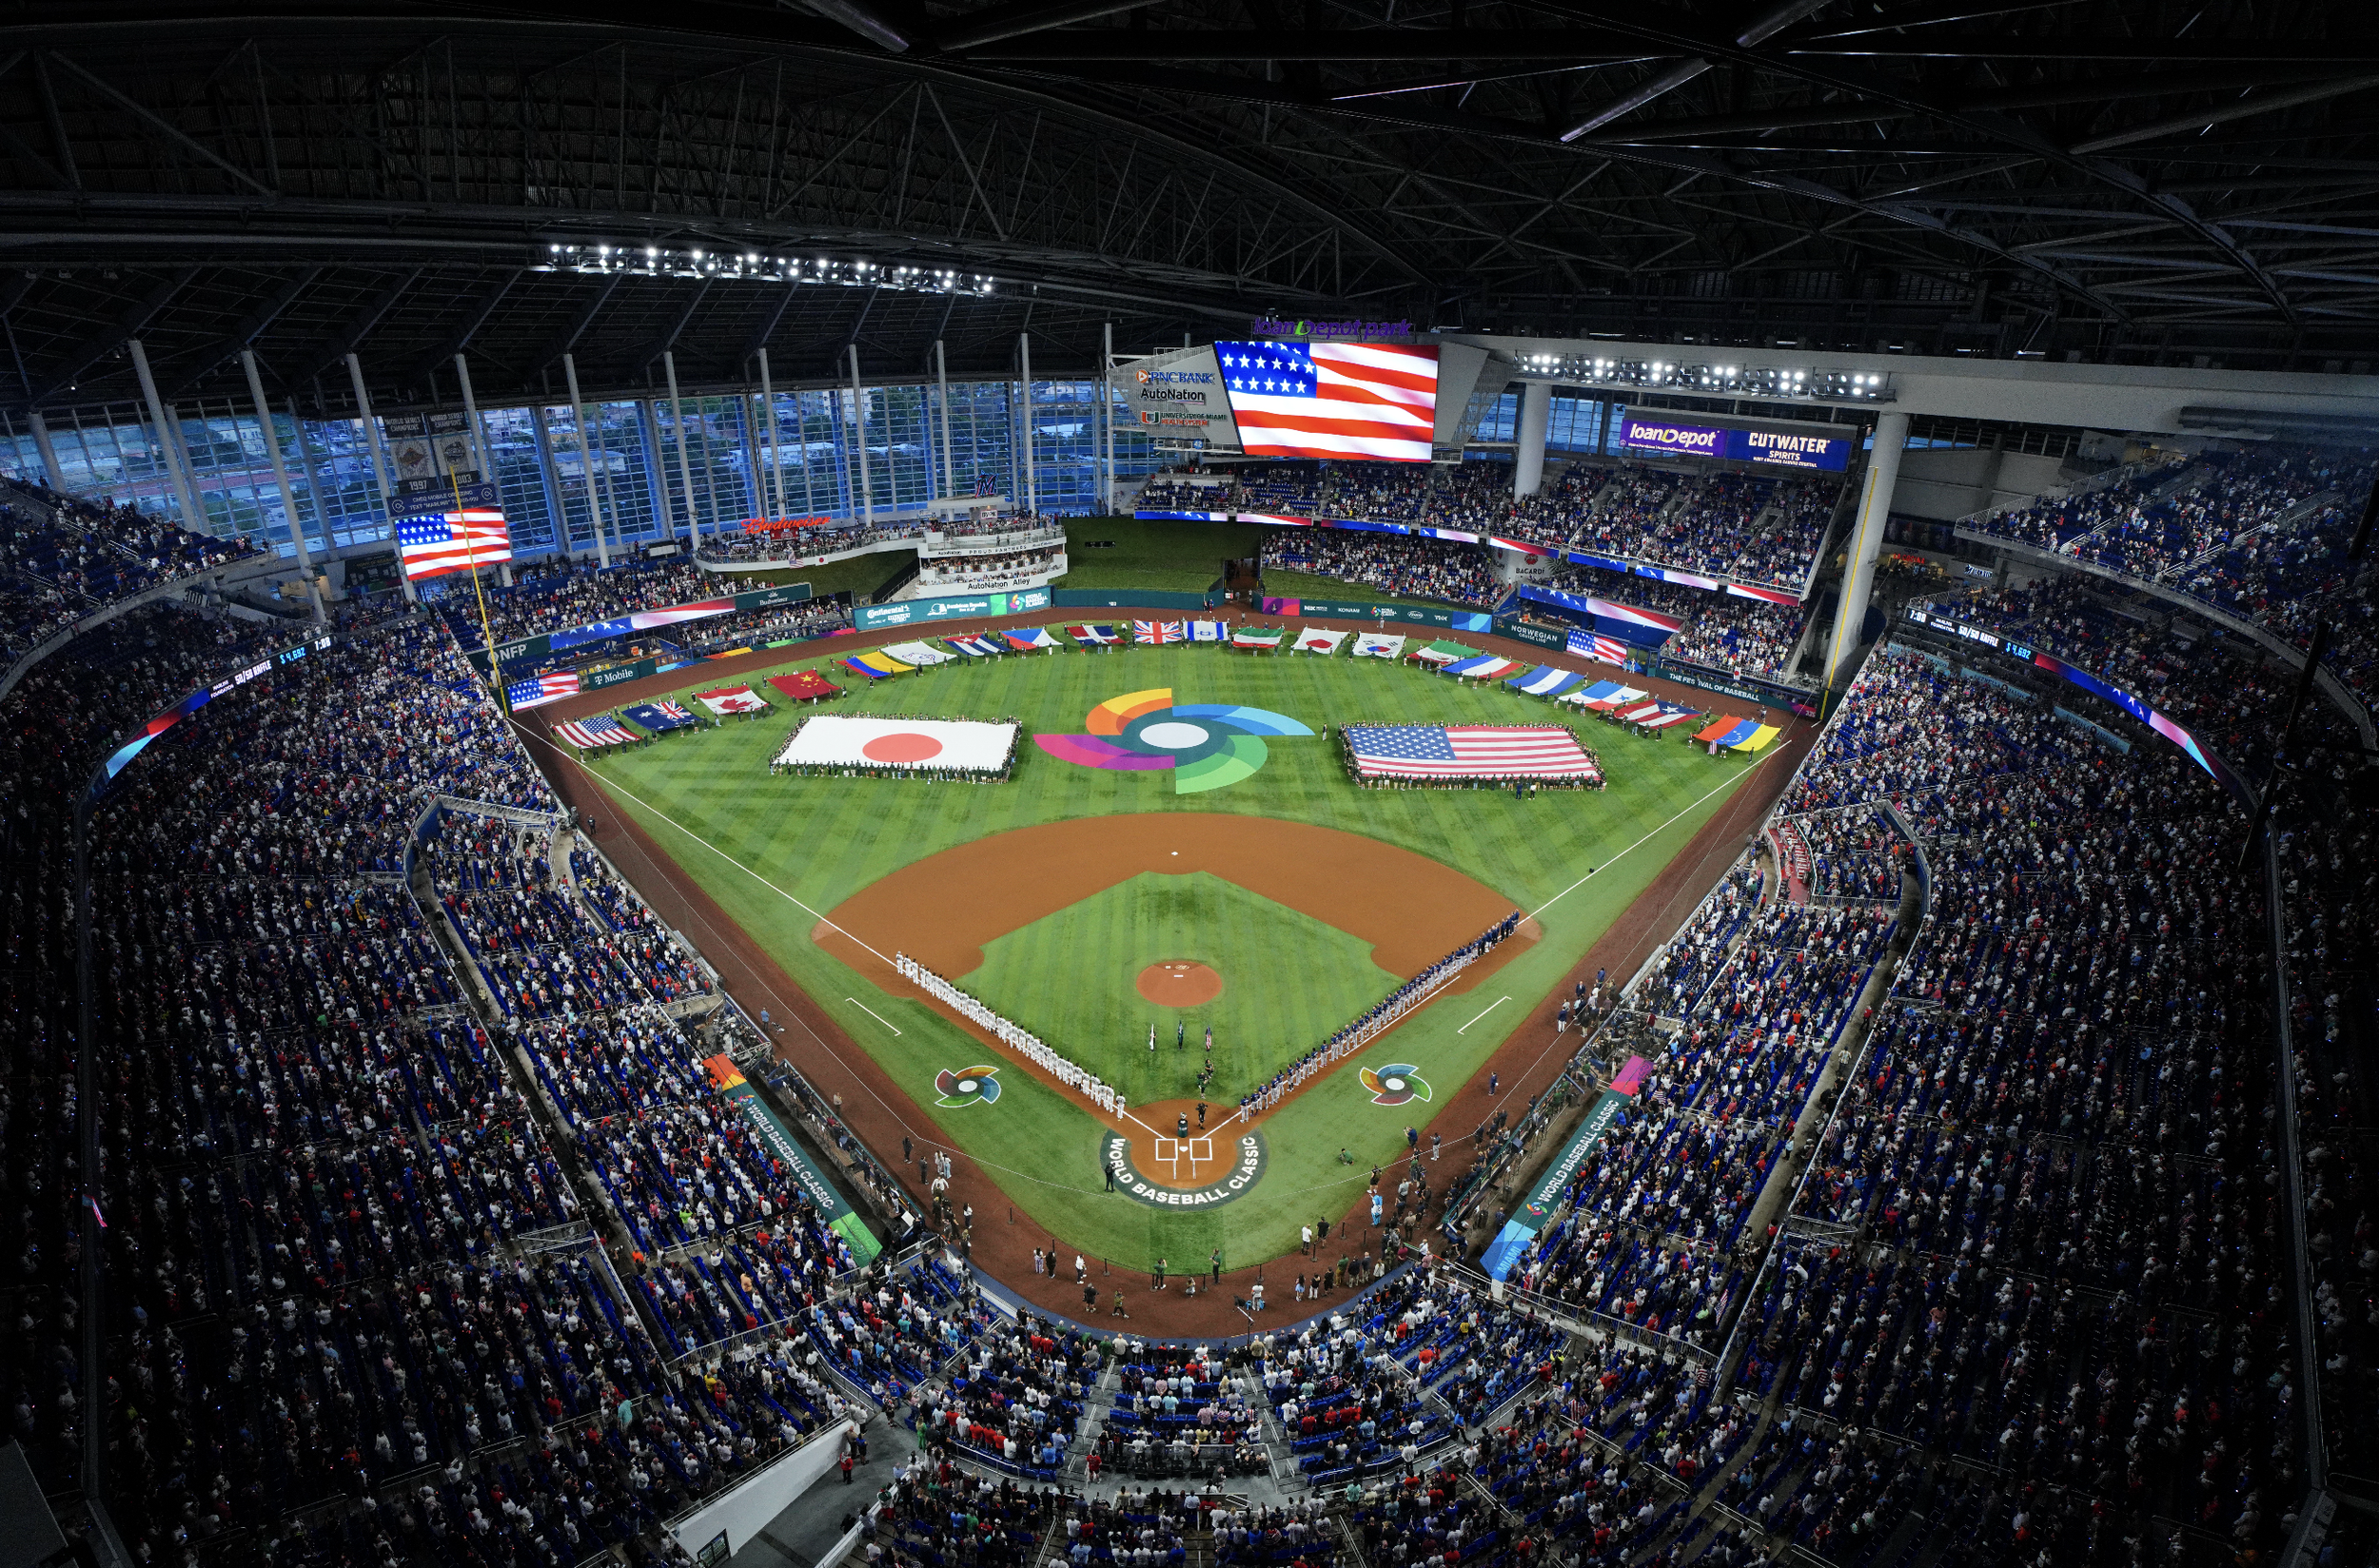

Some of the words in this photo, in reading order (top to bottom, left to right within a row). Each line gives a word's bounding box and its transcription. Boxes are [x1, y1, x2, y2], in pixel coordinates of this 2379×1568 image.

[1253, 317, 1362, 340] loanDepot
[1364, 319, 1412, 340] park
[1150, 371, 1178, 382] PNC
[1179, 372, 1213, 383] BANK
[1141, 388, 1205, 400] AutoNation
[390, 423, 419, 432] CHAMPIONS
[434, 420, 462, 428] CHAMPIONS
[1629, 423, 1716, 448] loanDepot
[1749, 432, 1827, 454] CUTWATER
[1769, 450, 1800, 461] SPIRITS
[409, 480, 427, 491] 1997
[740, 515, 831, 535] Budweiser
[968, 581, 1008, 590] AutoNation
[759, 597, 788, 606] Budweiser
[867, 605, 904, 618] Continental
[1910, 610, 1927, 623] 7:08
[1511, 624, 1558, 642] NORWEGIAN
[1519, 632, 1535, 640] CRUISE
[1958, 625, 1979, 640] 50/50
[1979, 632, 1998, 647] RAFFLE
[286, 647, 305, 661] 4,692
[500, 644, 527, 661] NFP
[2012, 644, 2031, 659] 4,692
[234, 668, 254, 685] 50/50
[253, 659, 272, 676] RAFFLE
[604, 668, 634, 683] Mobile
[1669, 674, 1681, 682] THE
[1682, 676, 1713, 690] FESIVAL
[1724, 686, 1760, 702] BASEBALL
[747, 1104, 775, 1133] WORLD
[768, 1127, 805, 1173] BASEBALL
[799, 1170, 835, 1208] CLASSIC
[1538, 1169, 1568, 1203] WORLD
[1564, 1131, 1598, 1171] BASEBALL
[1590, 1100, 1619, 1132] CLASSIC
[1109, 1138, 1134, 1185] WORLD
[1131, 1183, 1229, 1205] BASEBALL
[1229, 1136, 1259, 1189] CLASSIC
[1497, 1245, 1522, 1273] MIAMI
